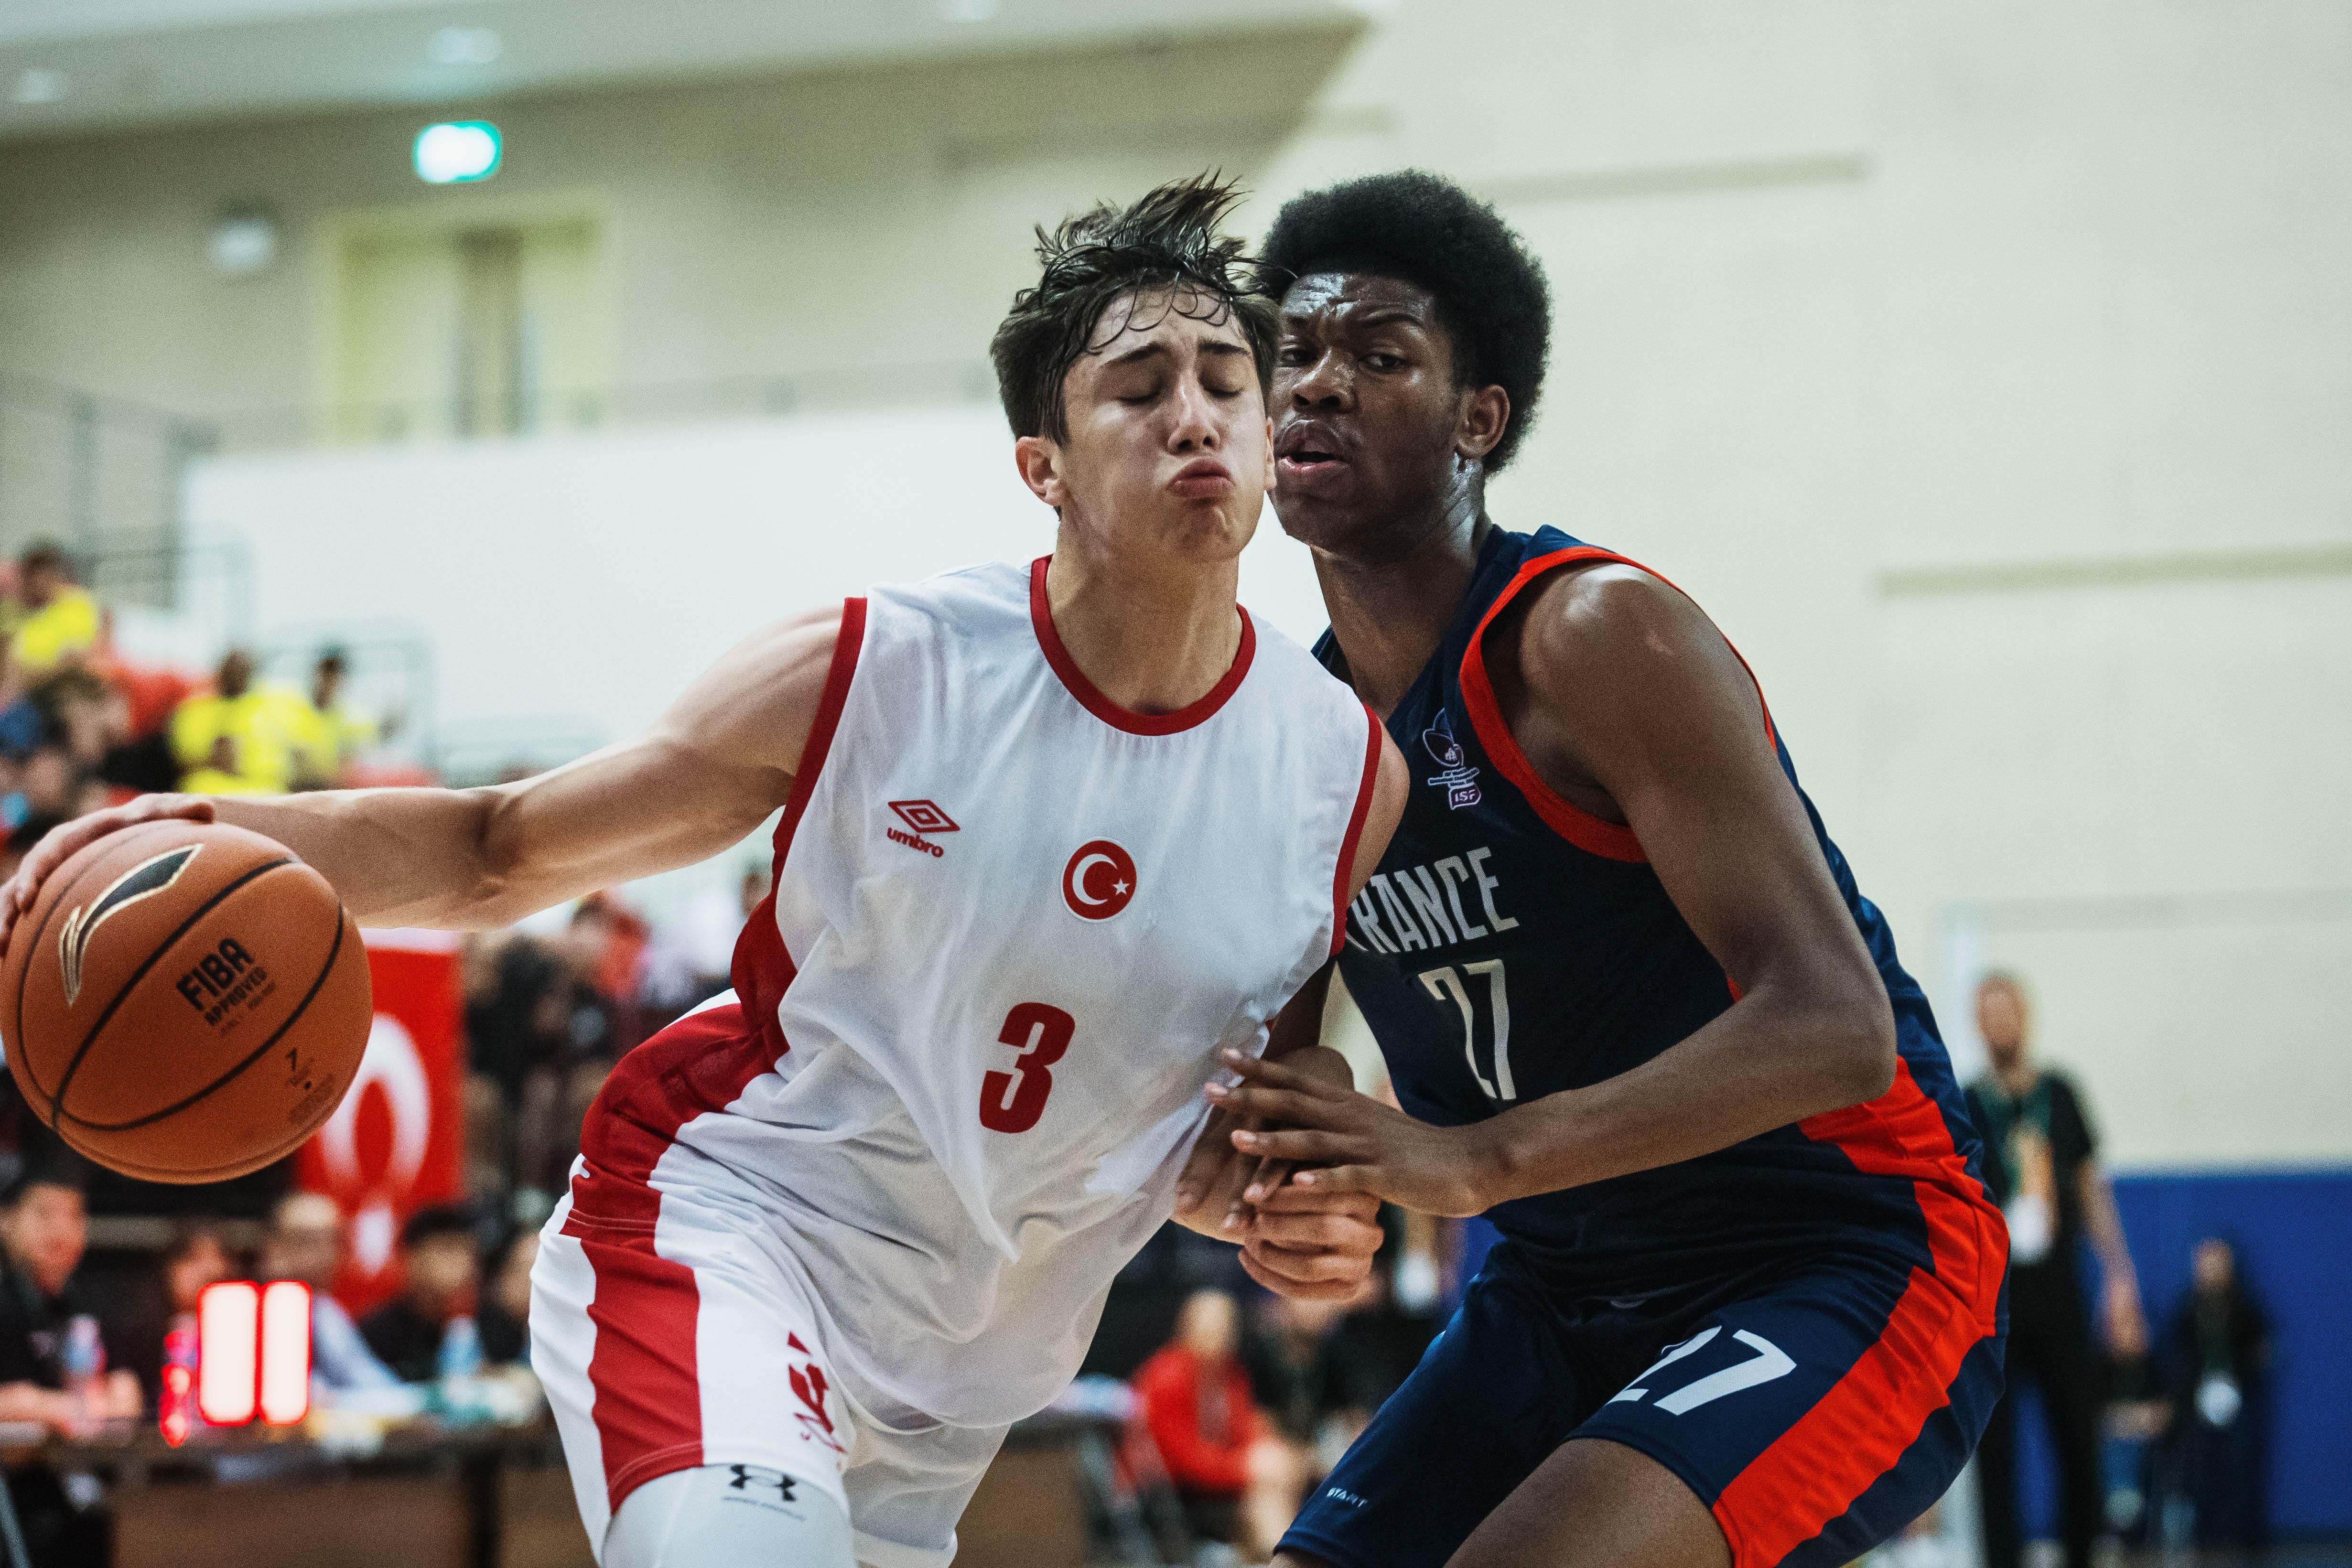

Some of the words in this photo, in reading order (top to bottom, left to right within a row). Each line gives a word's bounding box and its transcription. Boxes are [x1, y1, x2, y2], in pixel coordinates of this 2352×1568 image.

[1455, 789, 1476, 802] ISF
[887, 827, 944, 858] umbro
[1345, 846, 1520, 954] RANCE
[176, 938, 255, 1011] FIBA
[204, 966, 267, 1027] APPROVED
[980, 1002, 1075, 1134] 3
